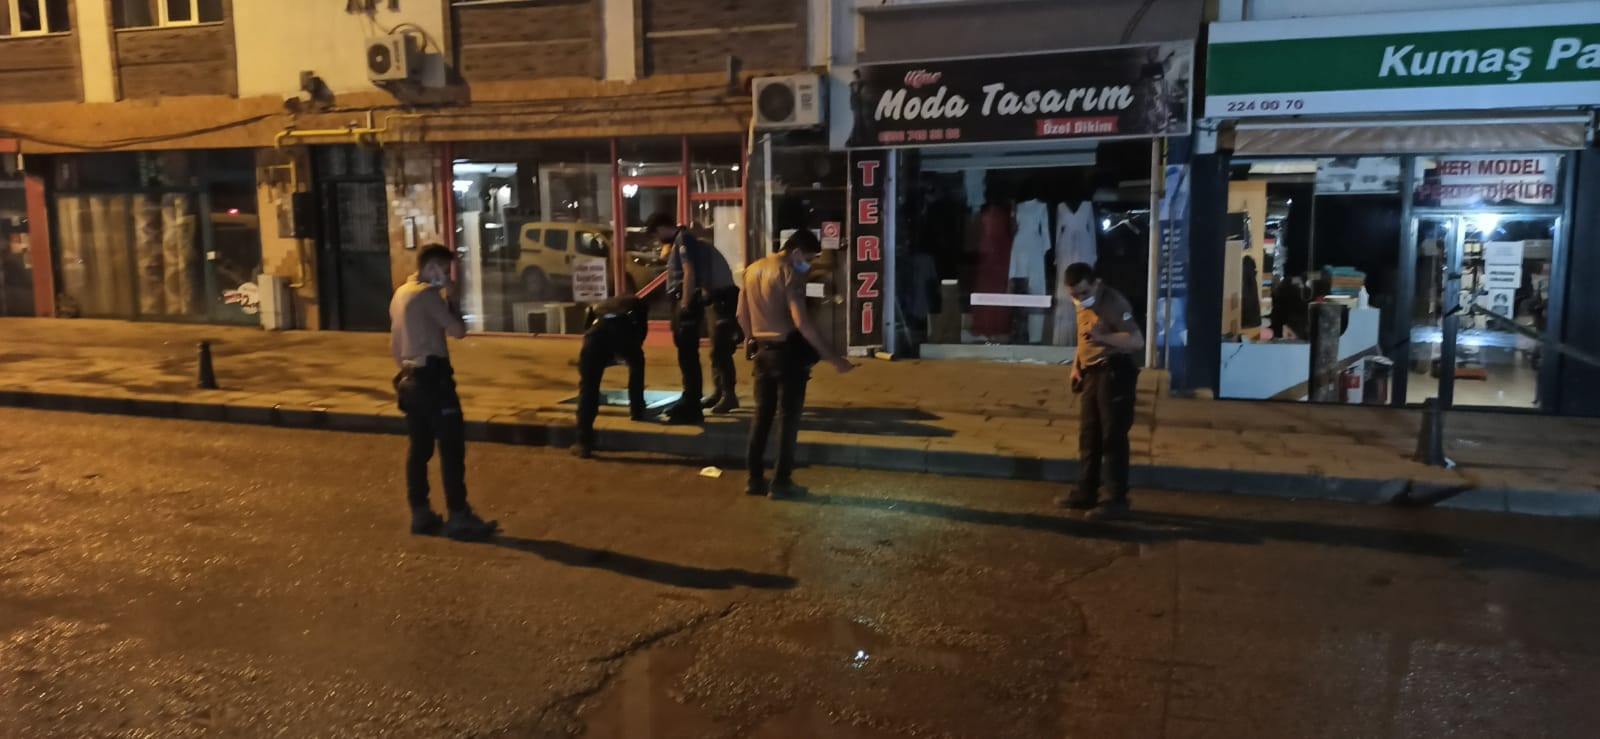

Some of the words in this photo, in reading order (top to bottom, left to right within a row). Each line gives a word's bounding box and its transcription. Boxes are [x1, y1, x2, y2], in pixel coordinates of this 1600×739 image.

[1378, 44, 1533, 82] Kumaş
[1545, 37, 1600, 71] Pa
[874, 85, 970, 121] Moda
[981, 82, 1135, 117] Tasarım
[1227, 101, 1255, 112] 224
[1260, 100, 1280, 111] 00
[1286, 99, 1304, 110] 70
[1436, 159, 1471, 176] HER
[1478, 158, 1545, 175] MODEL
[856, 160, 881, 334] TERZİ
